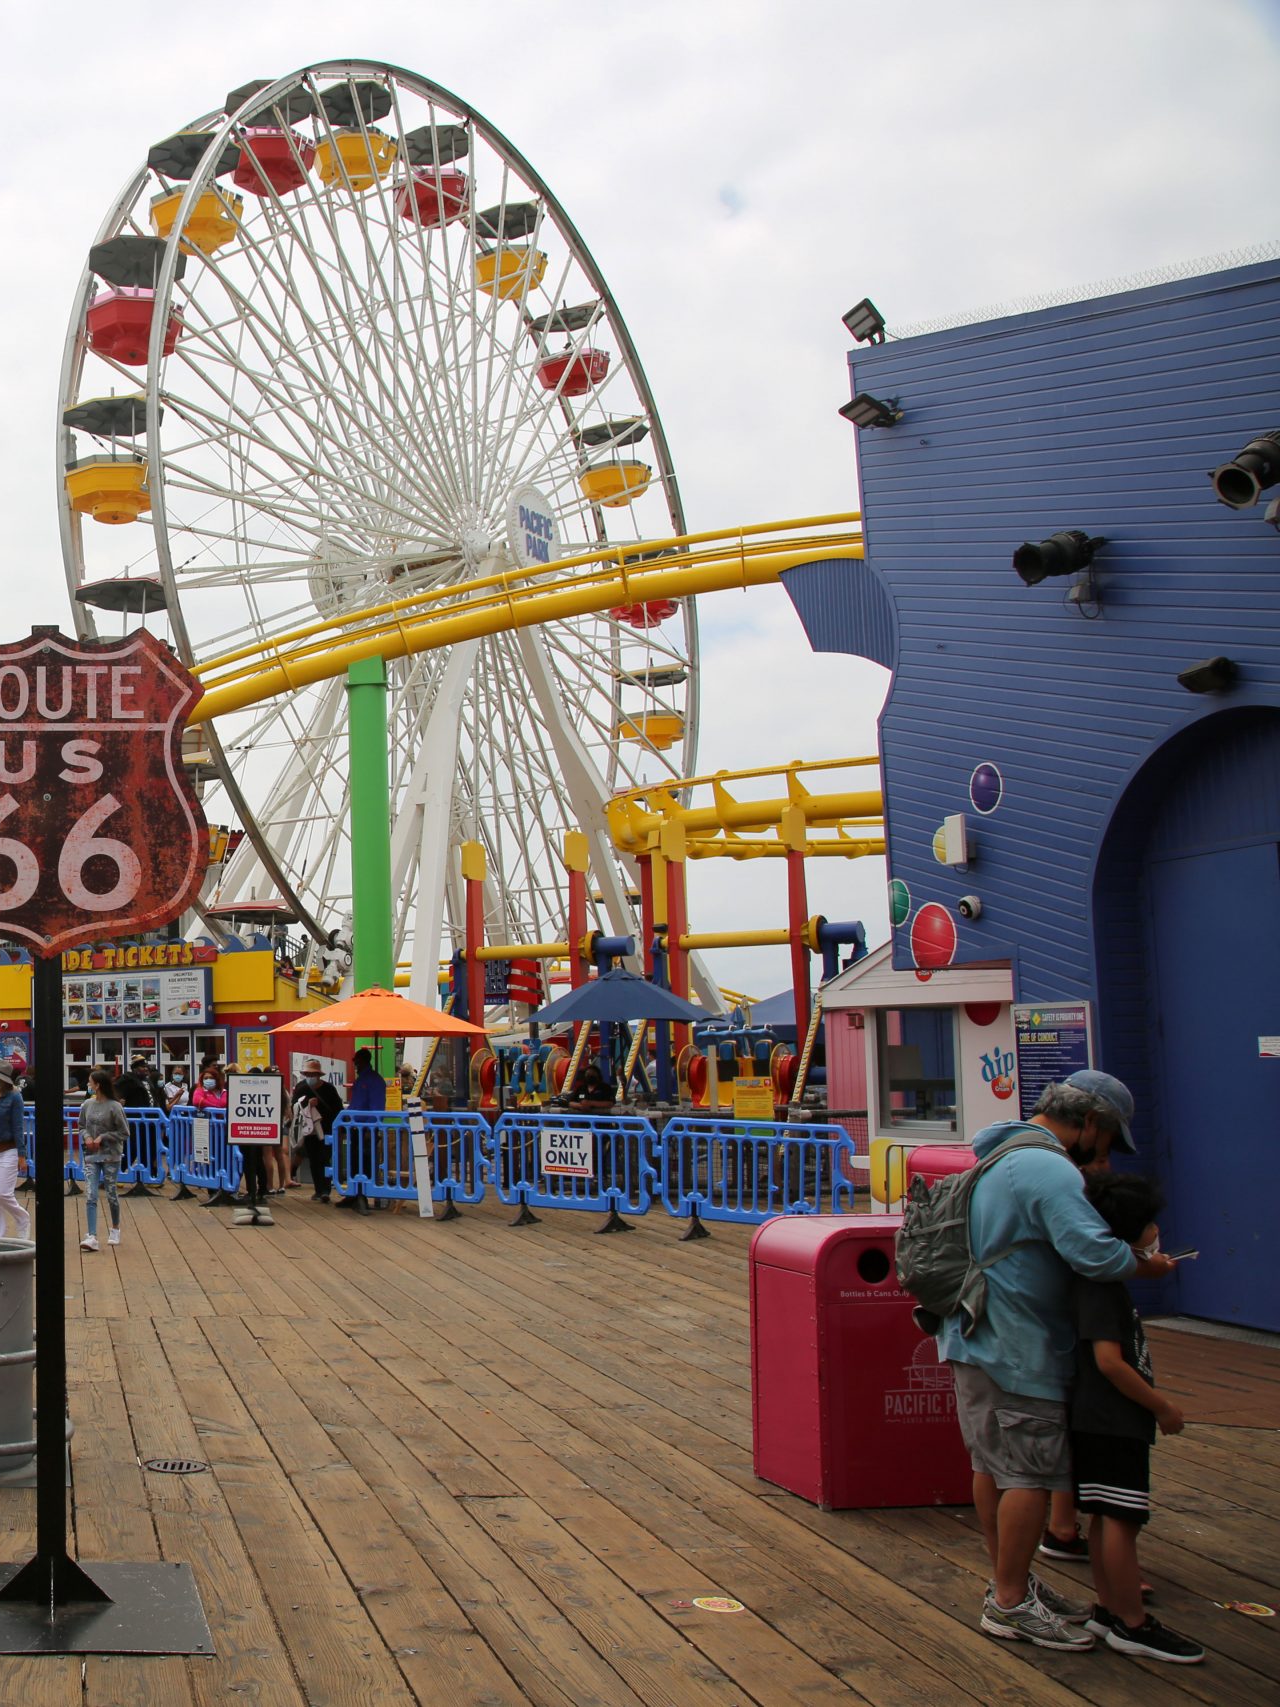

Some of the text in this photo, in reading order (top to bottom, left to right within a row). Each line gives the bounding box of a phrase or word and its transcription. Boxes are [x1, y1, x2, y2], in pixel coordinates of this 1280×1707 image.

[519, 505, 553, 541] PACIFIC
[526, 533, 550, 563] PARK
[62, 942, 194, 971] IDE TICKETS
[979, 1047, 1014, 1082] dip
[239, 1093, 271, 1105] EXIT
[235, 1106, 274, 1117] ONLY
[550, 1134, 583, 1149] EXIT
[545, 1150, 588, 1166] ONLY
[840, 1290, 865, 1298] Bottles
[884, 1393, 942, 1416] PACIFIC
